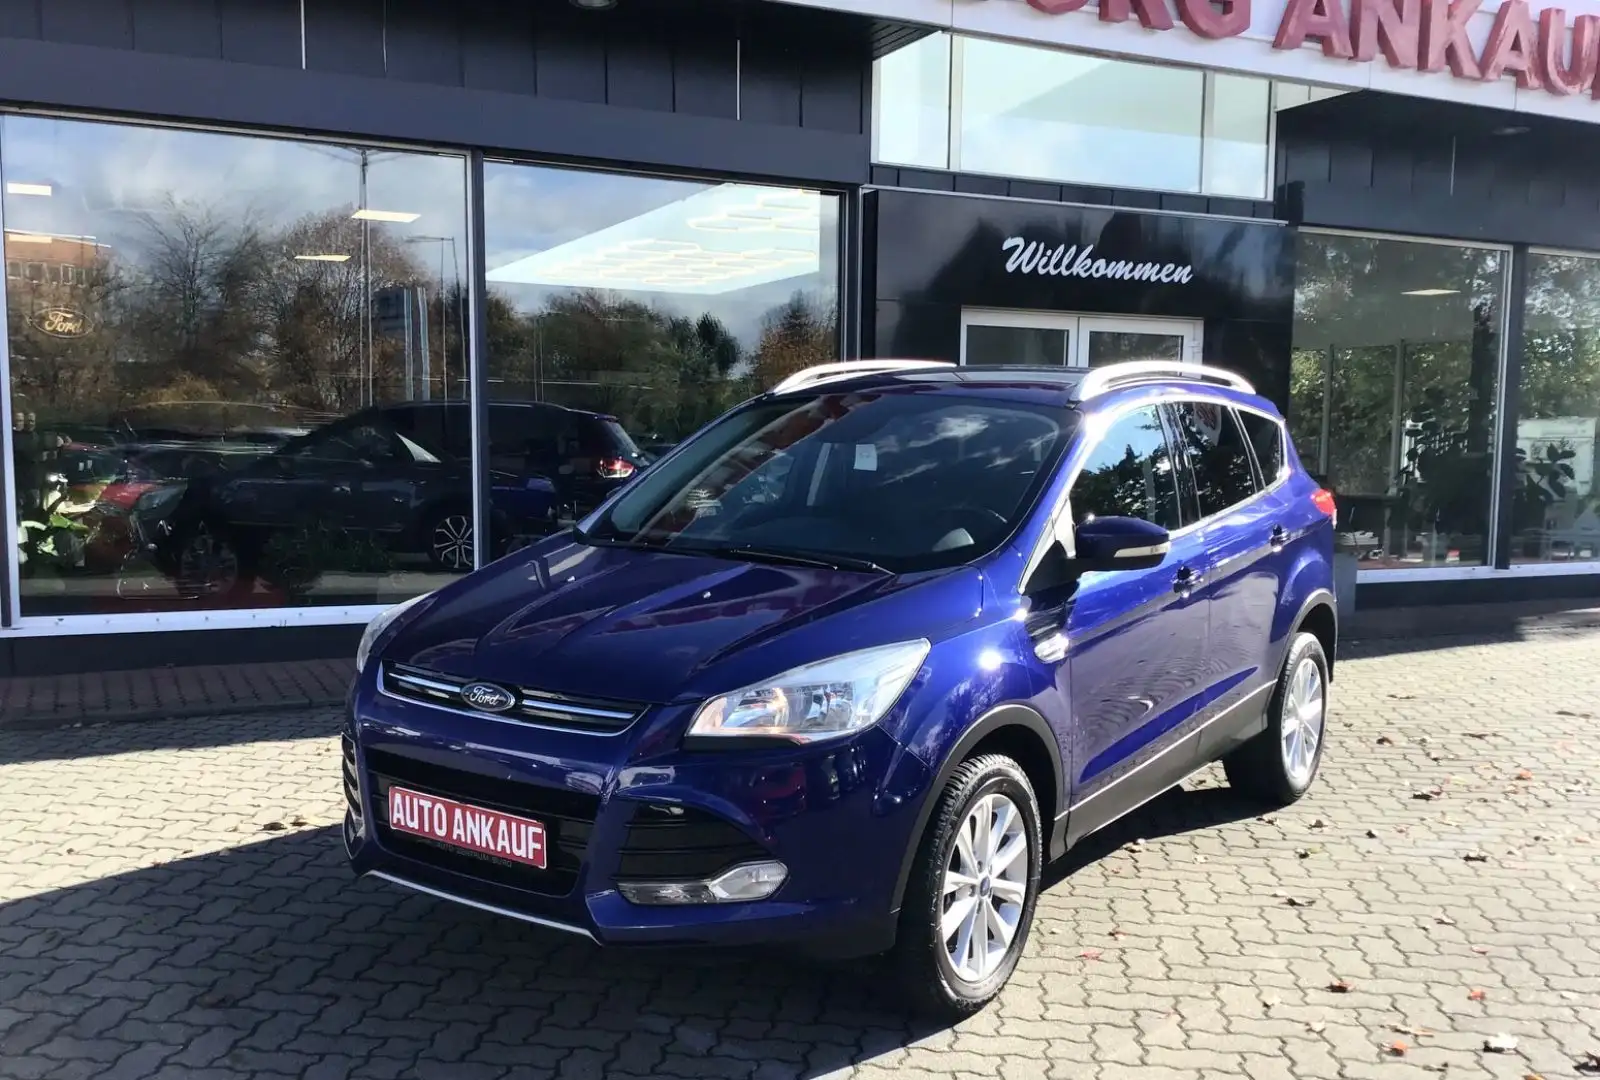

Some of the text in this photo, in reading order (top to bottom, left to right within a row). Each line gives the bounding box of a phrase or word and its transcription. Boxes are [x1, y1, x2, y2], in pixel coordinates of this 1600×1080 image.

[1271, 0, 1600, 101] ANKAU
[1002, 236, 1193, 284] Willkommen
[45, 311, 83, 333] Ford
[470, 686, 500, 706] Ford
[393, 792, 447, 838] AUTO
[452, 808, 543, 860] ANKAUF
